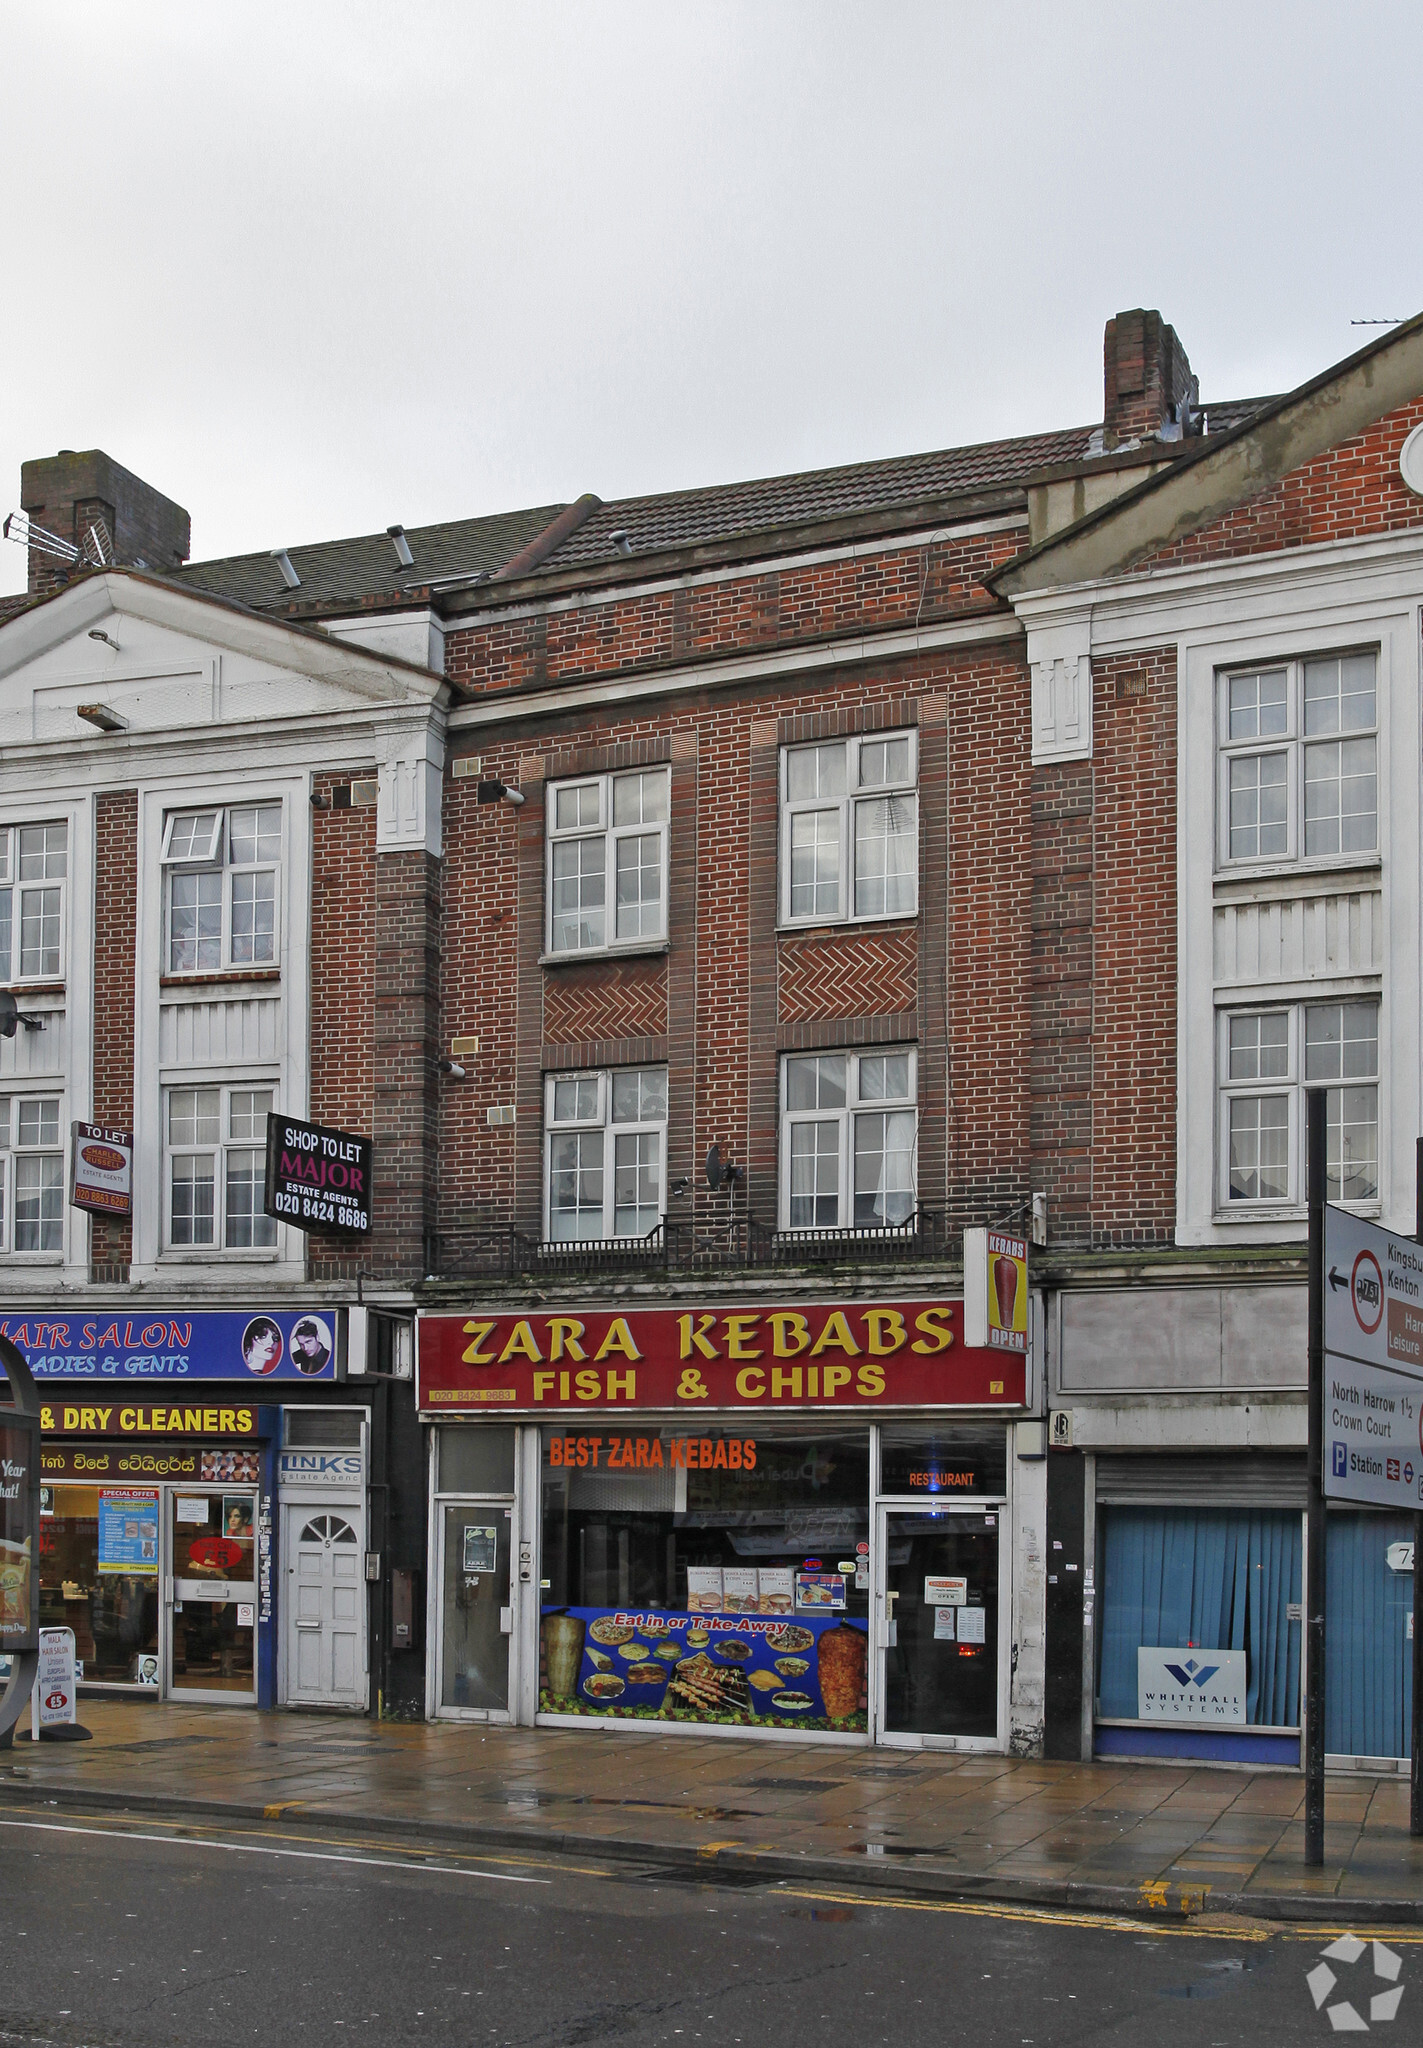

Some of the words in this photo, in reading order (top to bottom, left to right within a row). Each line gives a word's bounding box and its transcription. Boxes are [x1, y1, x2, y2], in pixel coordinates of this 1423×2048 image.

[85, 1126, 101, 1138] TO
[105, 1130, 127, 1144] LET
[285, 1127, 319, 1152] SHOP
[321, 1136, 337, 1157] TO
[340, 1141, 362, 1163] LET
[86, 1147, 122, 1160] CHARLES
[86, 1156, 120, 1168] RUSSELL
[82, 1169, 102, 1178] ESTATE
[103, 1174, 123, 1182] AGENTS
[280, 1150, 364, 1192] MAJOR
[76, 1188, 89, 1200] 020
[286, 1182, 320, 1198] ESTATE
[323, 1191, 359, 1207] AGENTS
[275, 1192, 299, 1215] 020
[303, 1198, 335, 1222] 8424
[338, 1206, 367, 1230] 8686
[989, 1235, 1024, 1258] KEBABS
[1388, 1269, 1419, 1297] Kenton
[79, 1320, 192, 1350] SALON
[462, 1317, 644, 1364] ZARA
[676, 1307, 954, 1360] KEBABS
[991, 1328, 1024, 1349] OPEN
[1389, 1330, 1419, 1356] Leisure
[25, 1354, 96, 1374] LADIES
[101, 1355, 120, 1374] &
[124, 1354, 190, 1375] GENTS
[533, 1369, 636, 1400] FISH
[677, 1368, 709, 1399] &
[735, 1364, 886, 1398] CHIPS
[992, 1383, 1001, 1393] 7
[434, 1391, 453, 1400] 020
[457, 1391, 481, 1400] 8424
[486, 1390, 511, 1400] 9683
[1332, 1381, 1359, 1404] North
[1364, 1389, 1395, 1413] Harrow
[40, 1407, 55, 1429] &
[63, 1407, 113, 1430] DRY
[119, 1407, 253, 1433] CLEANERS
[1332, 1408, 1362, 1431] Crown
[1366, 1416, 1391, 1438] Court
[550, 1437, 602, 1468] BEST
[607, 1437, 664, 1468] ZARA
[670, 1438, 757, 1470] KEBABS
[1335, 1445, 1345, 1474] P
[1350, 1453, 1382, 1475] Station
[1, 1459, 26, 1477] Year
[281, 1455, 361, 1474] LINKS
[281, 1472, 318, 1480] Estate
[323, 1474, 358, 1483] Agenc
[909, 1472, 974, 1486] RESTAURANT
[103, 1490, 131, 1498] SPECIAL
[259, 1526, 264, 1534] 5
[324, 1540, 331, 1548] 5
[614, 1613, 643, 1626] Eat
[648, 1614, 663, 1628] in
[667, 1616, 687, 1628] or
[691, 1616, 788, 1635] Take-Away
[54, 1646, 68, 1655] SALON
[50, 1696, 62, 1708] £5
[1145, 1692, 1239, 1704] WHITEHALL
[1146, 1704, 1239, 1715] SYSTEMS
